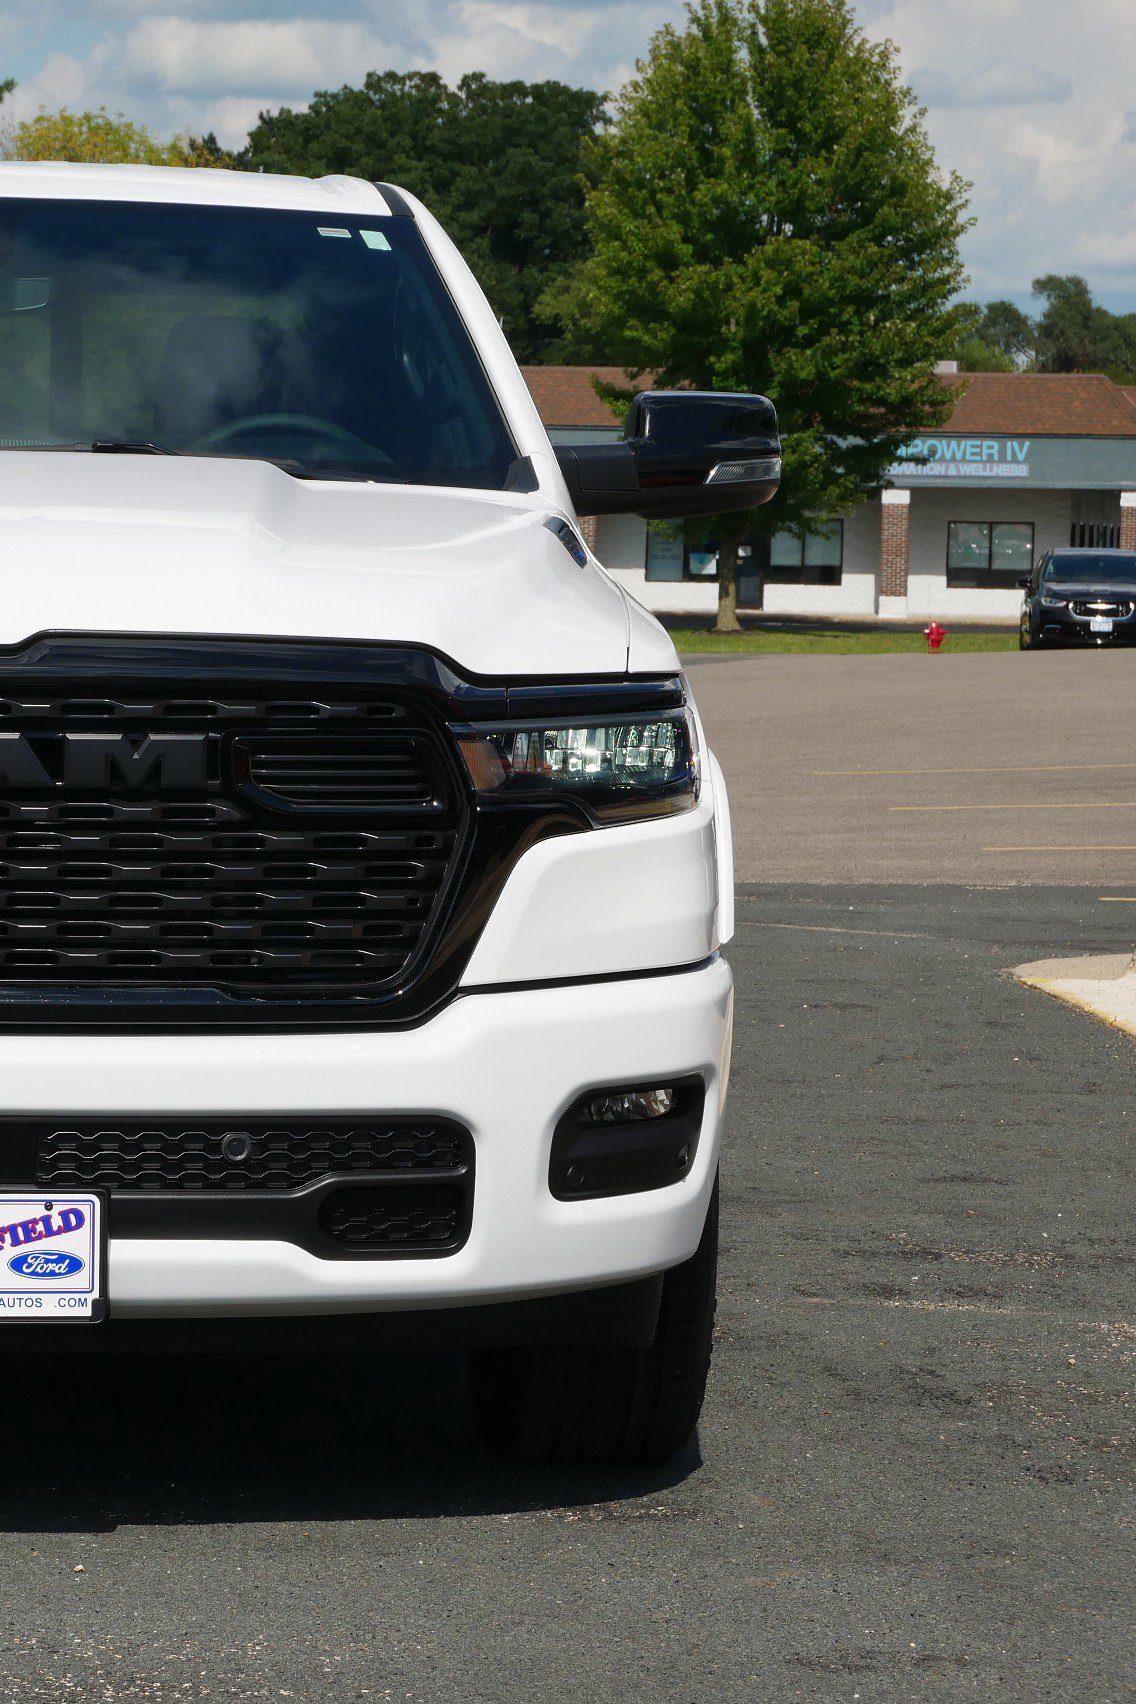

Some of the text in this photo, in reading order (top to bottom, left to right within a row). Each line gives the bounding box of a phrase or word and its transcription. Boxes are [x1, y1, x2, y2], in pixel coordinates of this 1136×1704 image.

[1006, 441, 1031, 462] IV
[886, 462, 946, 476] DRATION
[959, 464, 1028, 477] WELLNESS
[22, 1254, 69, 1274] Ford
[54, 1297, 89, 1308] .COM
